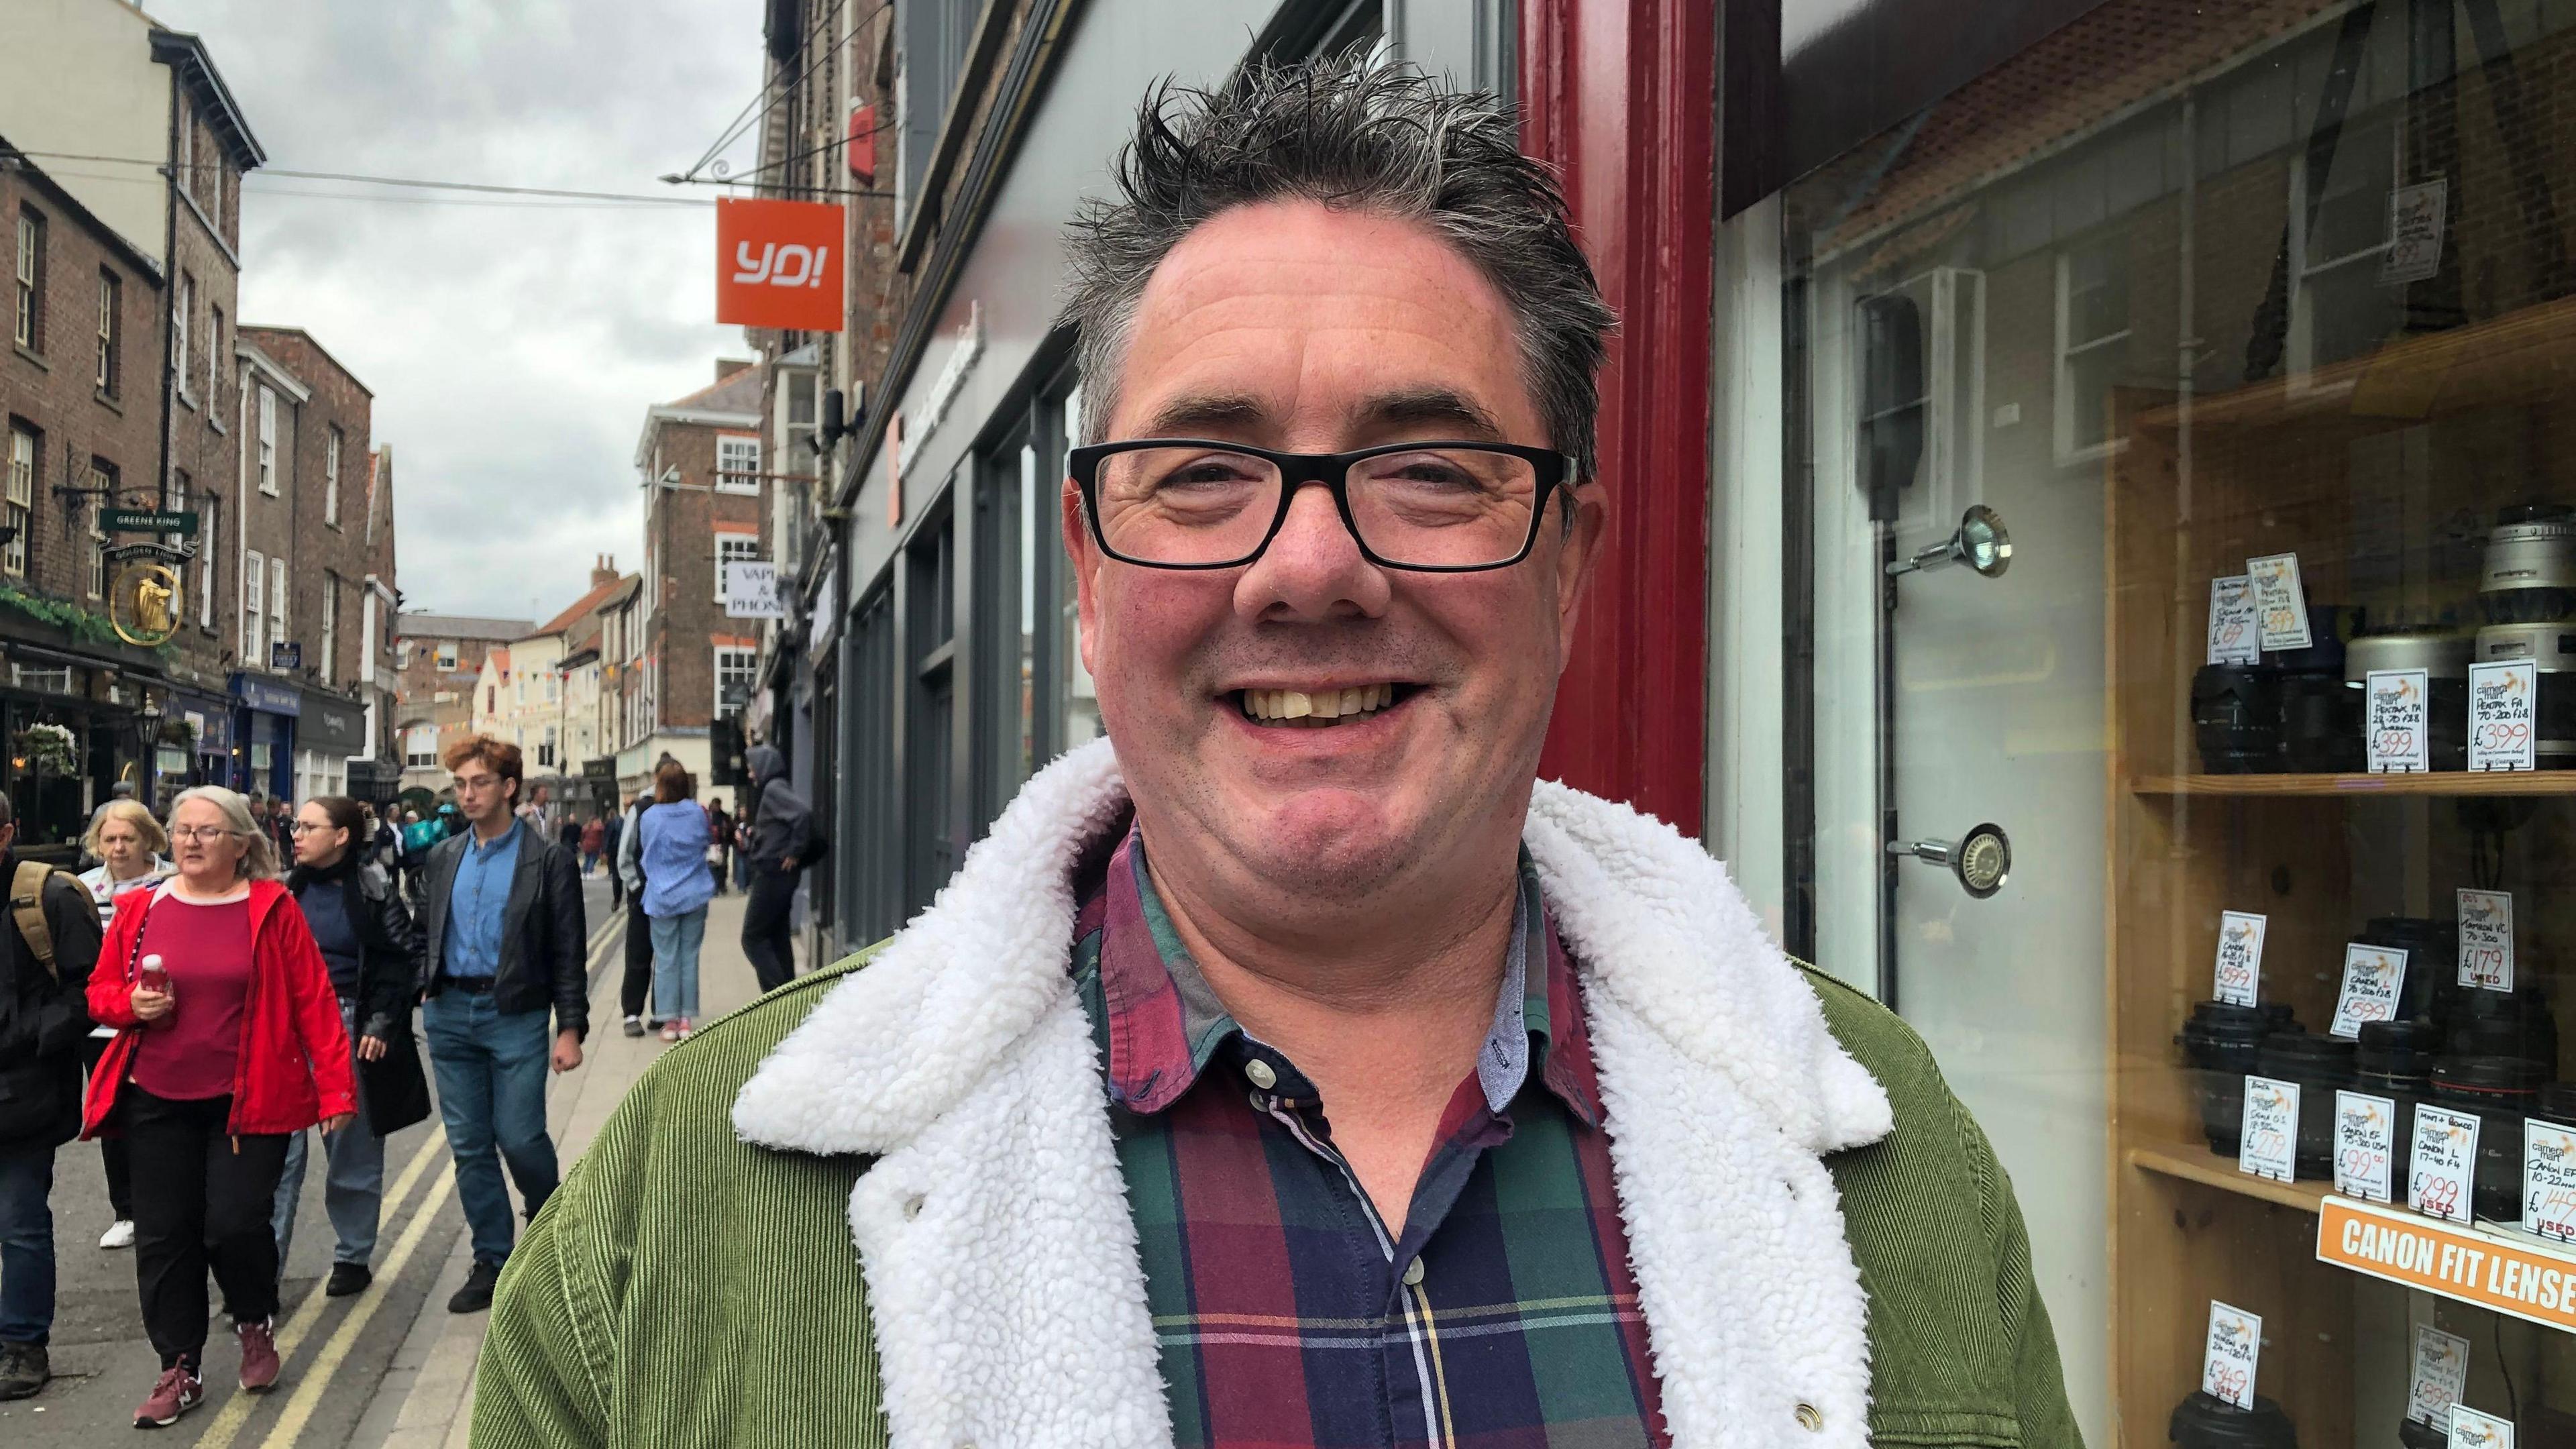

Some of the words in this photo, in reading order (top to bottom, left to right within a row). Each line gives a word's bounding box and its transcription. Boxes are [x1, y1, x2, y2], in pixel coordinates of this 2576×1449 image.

[733, 240, 828, 288] YO!
[116, 515, 153, 526] GREENE
[156, 517, 180, 527] KING
[758, 584, 769, 596] &
[733, 598, 784, 611] PHON
[2477, 685, 2508, 695] camera
[2484, 692, 2504, 700] mart
[2375, 704, 2408, 713] PENTAX
[2477, 698, 2507, 710] PENTAX
[2511, 697, 2523, 708] FA
[2477, 709, 2512, 720] 70-200
[2372, 729, 2412, 754] £399
[2474, 723, 2529, 750] £399
[2496, 923, 2507, 934] VC
[2463, 949, 2502, 975] £179
[2218, 962, 2249, 987] £599
[2351, 975, 2379, 987] CANON
[2342, 996, 2386, 1020] £599
[2341, 1124, 2367, 1138] CANON
[2369, 1130, 2380, 1140] EF
[2420, 1126, 2449, 1140] camera
[2426, 1134, 2445, 1146] mart
[2418, 1140, 2444, 1155] CANON
[2451, 1148, 2459, 1159] L
[2532, 1142, 2565, 1157] camera
[2540, 1151, 2560, 1163] mart
[2420, 1152, 2444, 1167] 17-40
[2528, 1159, 2561, 1175] CANON
[2413, 1172, 2459, 1204] £299
[2419, 1197, 2455, 1214] USED
[2537, 1218, 2575, 1236] USED
[2342, 1218, 2435, 1276] CANON
[2438, 1243, 2485, 1289] FIT
[2487, 1255, 2576, 1315] LENSE
[2208, 1359, 2247, 1391] £349
[2414, 1379, 2453, 1413] £899
[2455, 1427, 2485, 1444] camera
[2463, 1436, 2481, 1448] mart
